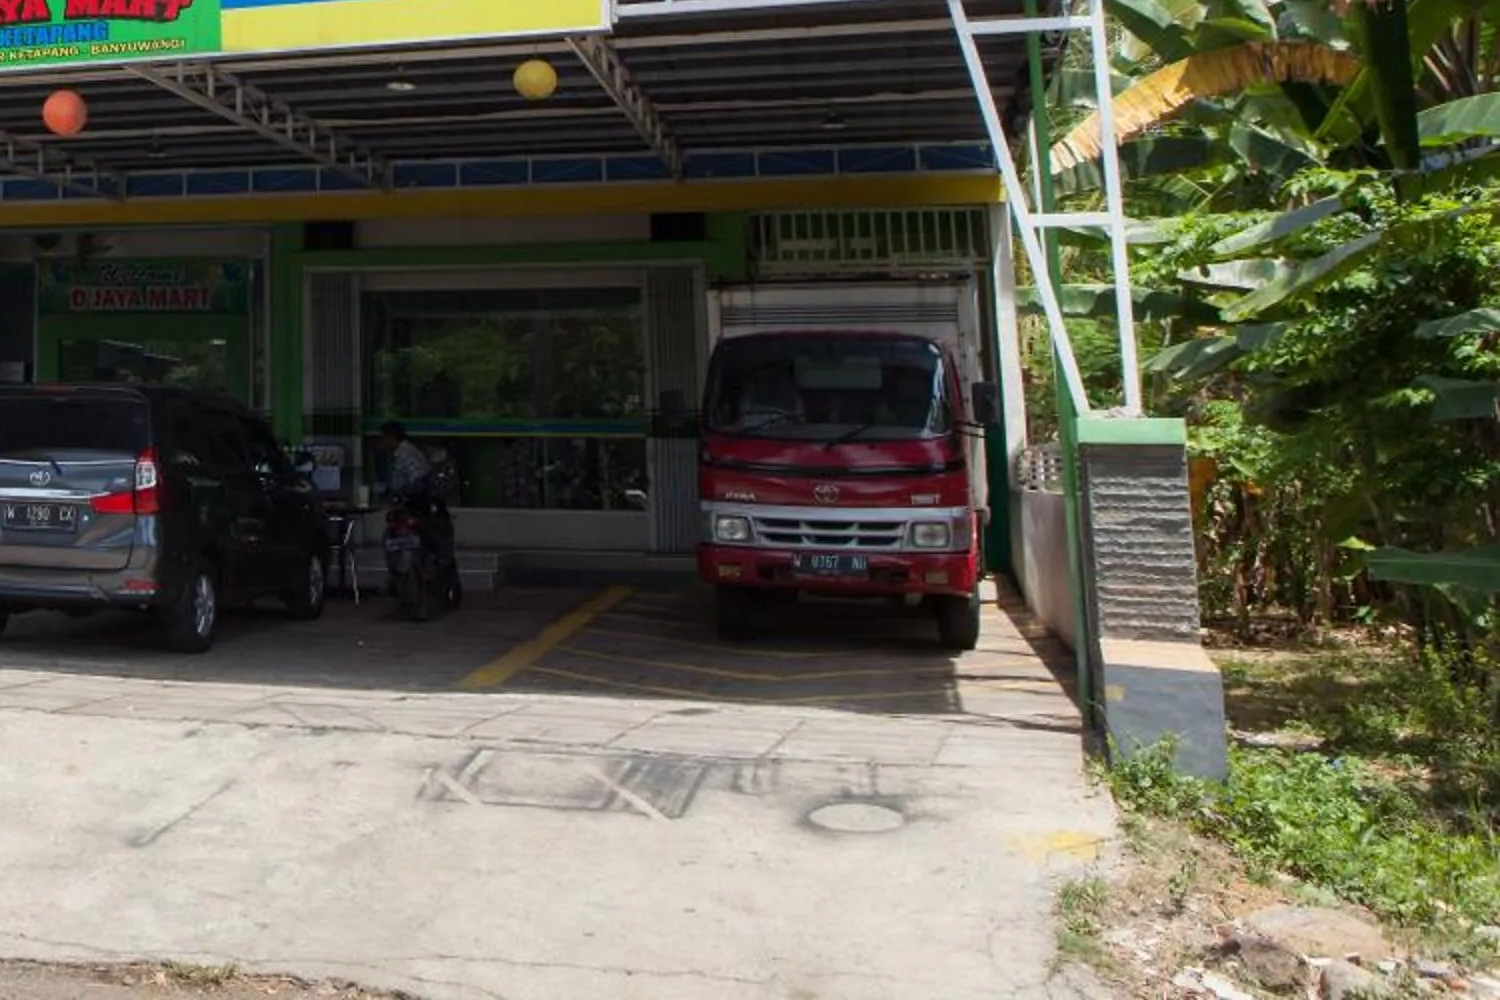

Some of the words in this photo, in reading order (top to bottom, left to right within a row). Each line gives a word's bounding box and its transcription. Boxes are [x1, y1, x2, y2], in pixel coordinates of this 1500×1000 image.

[8, 46, 79, 61] KETAPANG
[90, 39, 185, 55] BANYUWANGI
[147, 286, 210, 308] MART
